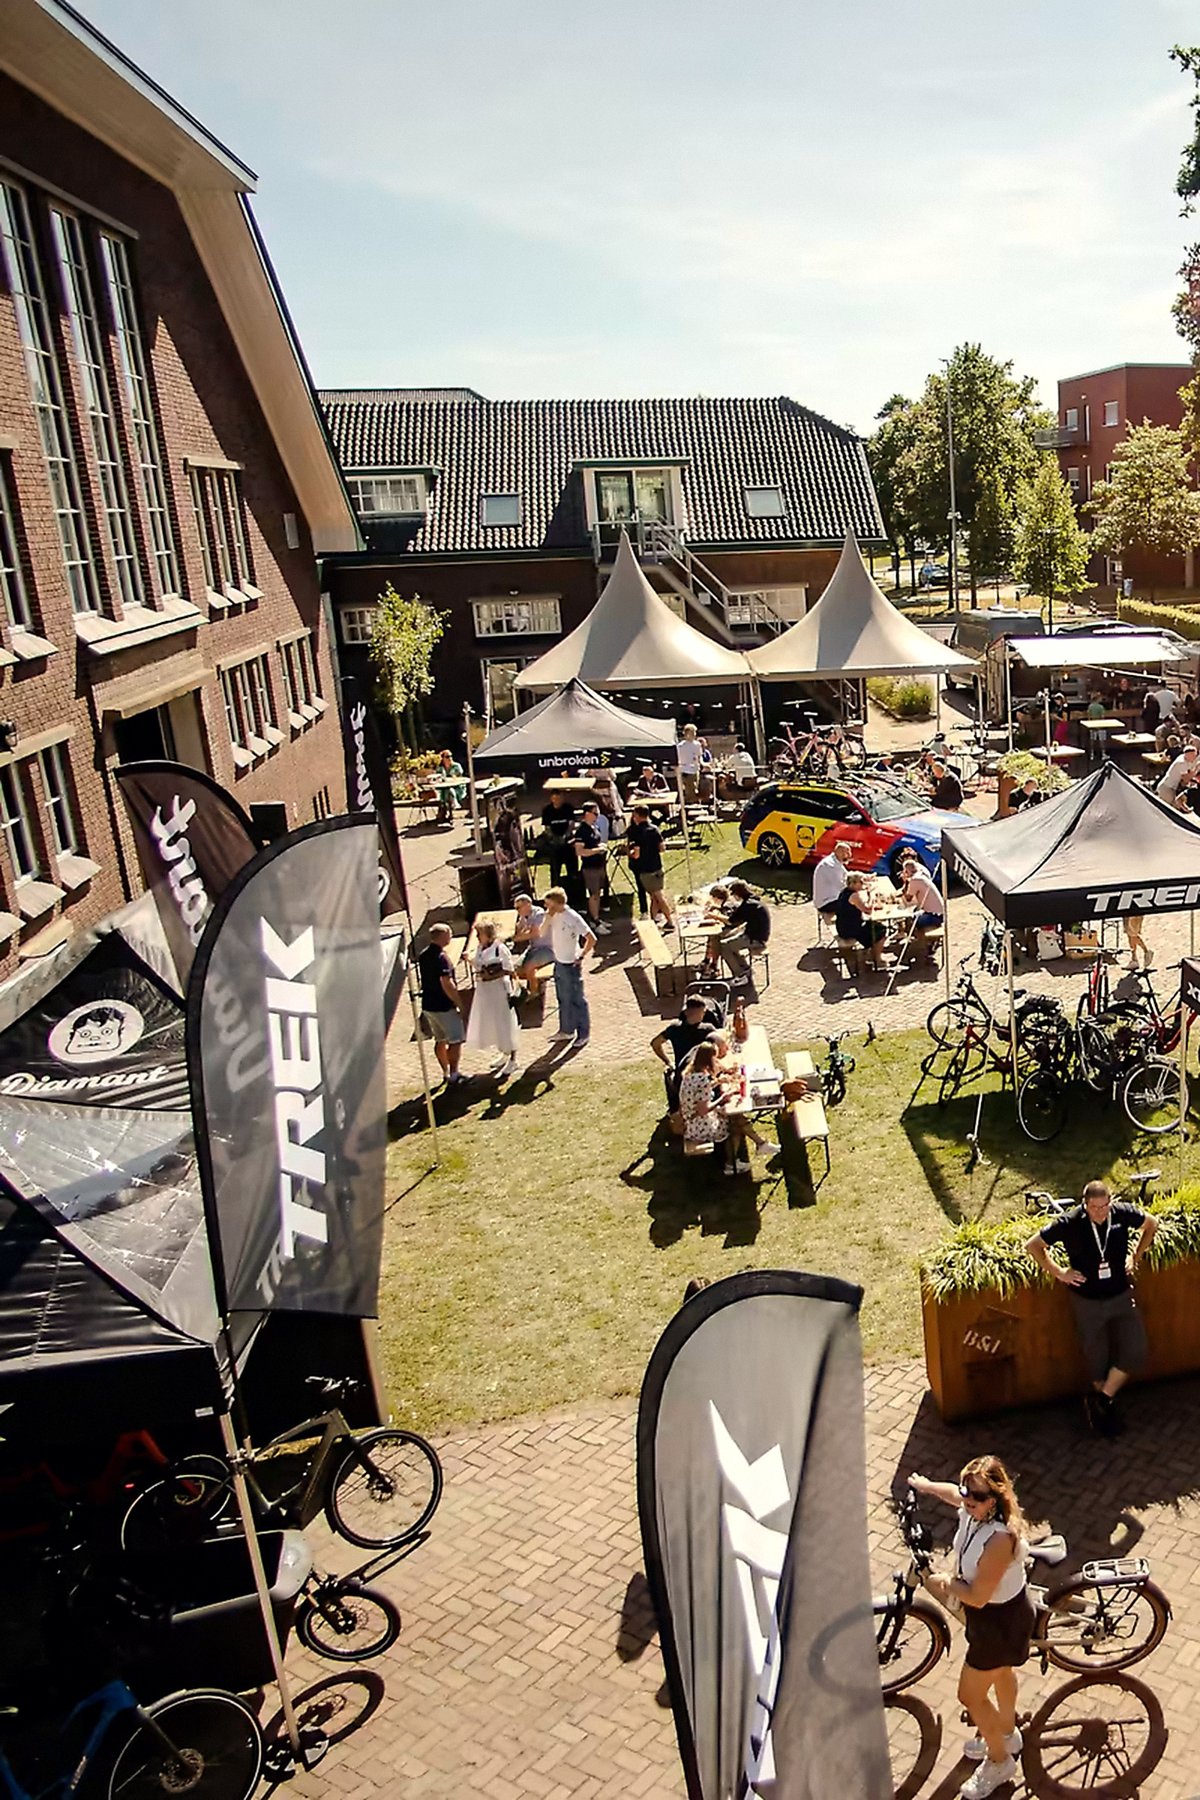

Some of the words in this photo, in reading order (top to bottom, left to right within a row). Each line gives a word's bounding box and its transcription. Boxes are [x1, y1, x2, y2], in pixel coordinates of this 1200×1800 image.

[538, 755, 599, 768] unbroken
[953, 852, 986, 899] TREK
[0, 1066, 169, 1096] Diamant
[261, 917, 329, 1259] TREK
